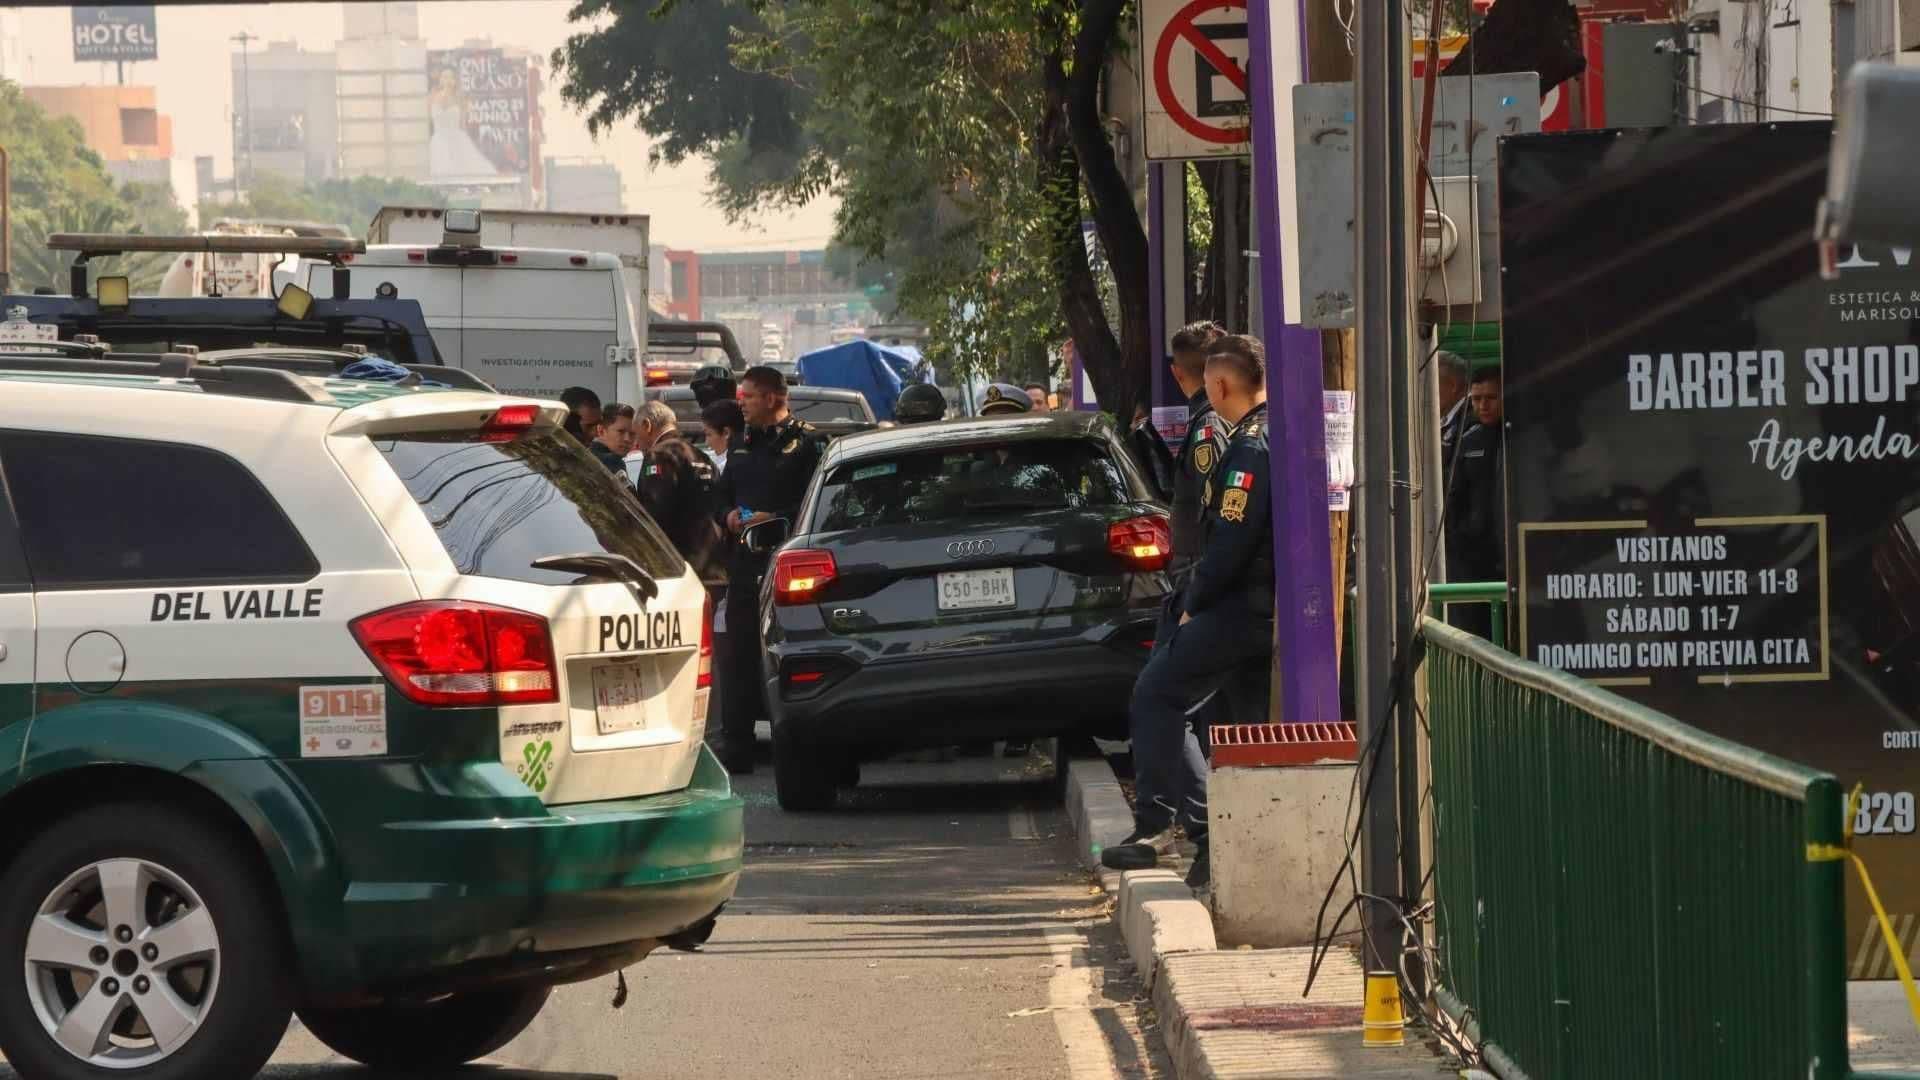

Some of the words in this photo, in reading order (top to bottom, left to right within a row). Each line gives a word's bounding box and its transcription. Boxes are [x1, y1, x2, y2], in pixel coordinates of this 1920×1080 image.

[76, 24, 154, 45] HOTEL
[1829, 291, 1902, 304] ESTETICA
[1841, 307, 1920, 321] MARISOL
[553, 360, 594, 368] FORENSE
[1628, 350, 1787, 411] BARBER
[1805, 345, 1919, 404] SHOP
[1749, 415, 1919, 480] Agenda
[1616, 535, 1727, 562] VISITANOS
[1547, 573, 1643, 600] HORARIO:
[1653, 570, 1748, 598] LUN-VIER
[1758, 568, 1798, 594] 11-8
[151, 592, 210, 621] DEL
[223, 588, 323, 619] VALLE
[1606, 604, 1690, 633] SÁBADO
[1700, 605, 1740, 631] 11-7
[599, 610, 682, 652] POLICIA
[1538, 643, 1632, 669] DOMINGO
[1637, 641, 1677, 668] CON
[1682, 640, 1757, 667] PREVIA
[1763, 638, 1810, 664] CITA
[1883, 731, 1920, 748] CORT
[1843, 792, 1915, 834] 829
